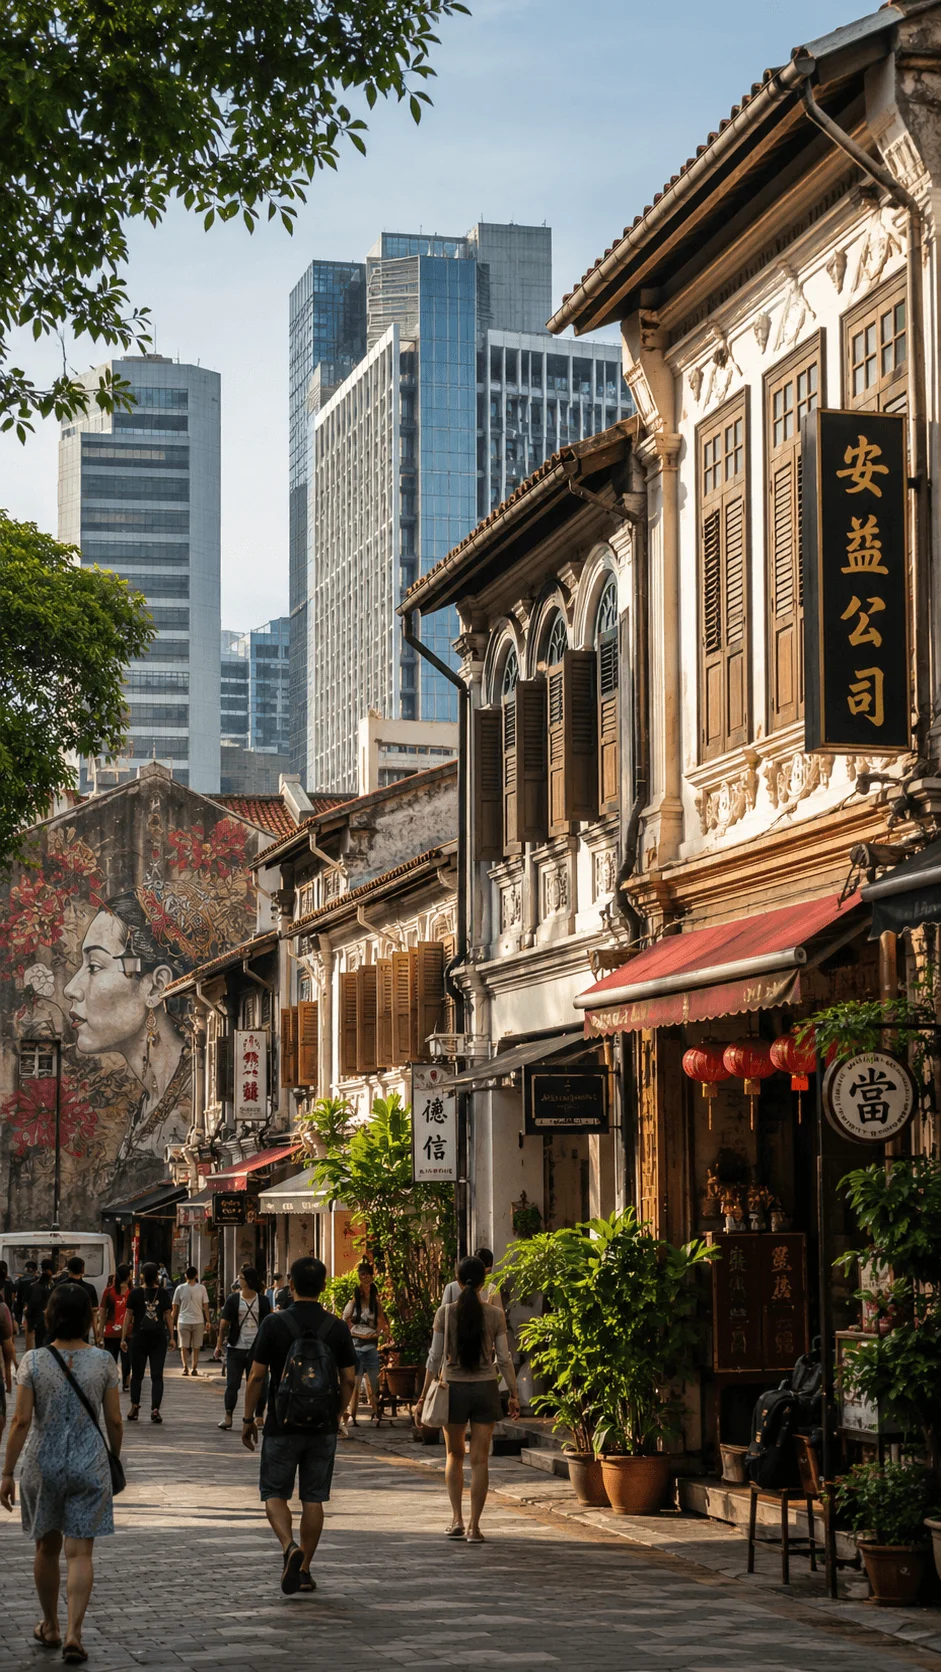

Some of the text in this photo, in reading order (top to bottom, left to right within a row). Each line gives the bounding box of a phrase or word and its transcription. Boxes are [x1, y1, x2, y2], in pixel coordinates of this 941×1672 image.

[836, 435, 889, 726] 安益公司
[849, 1067, 897, 1124] 當
